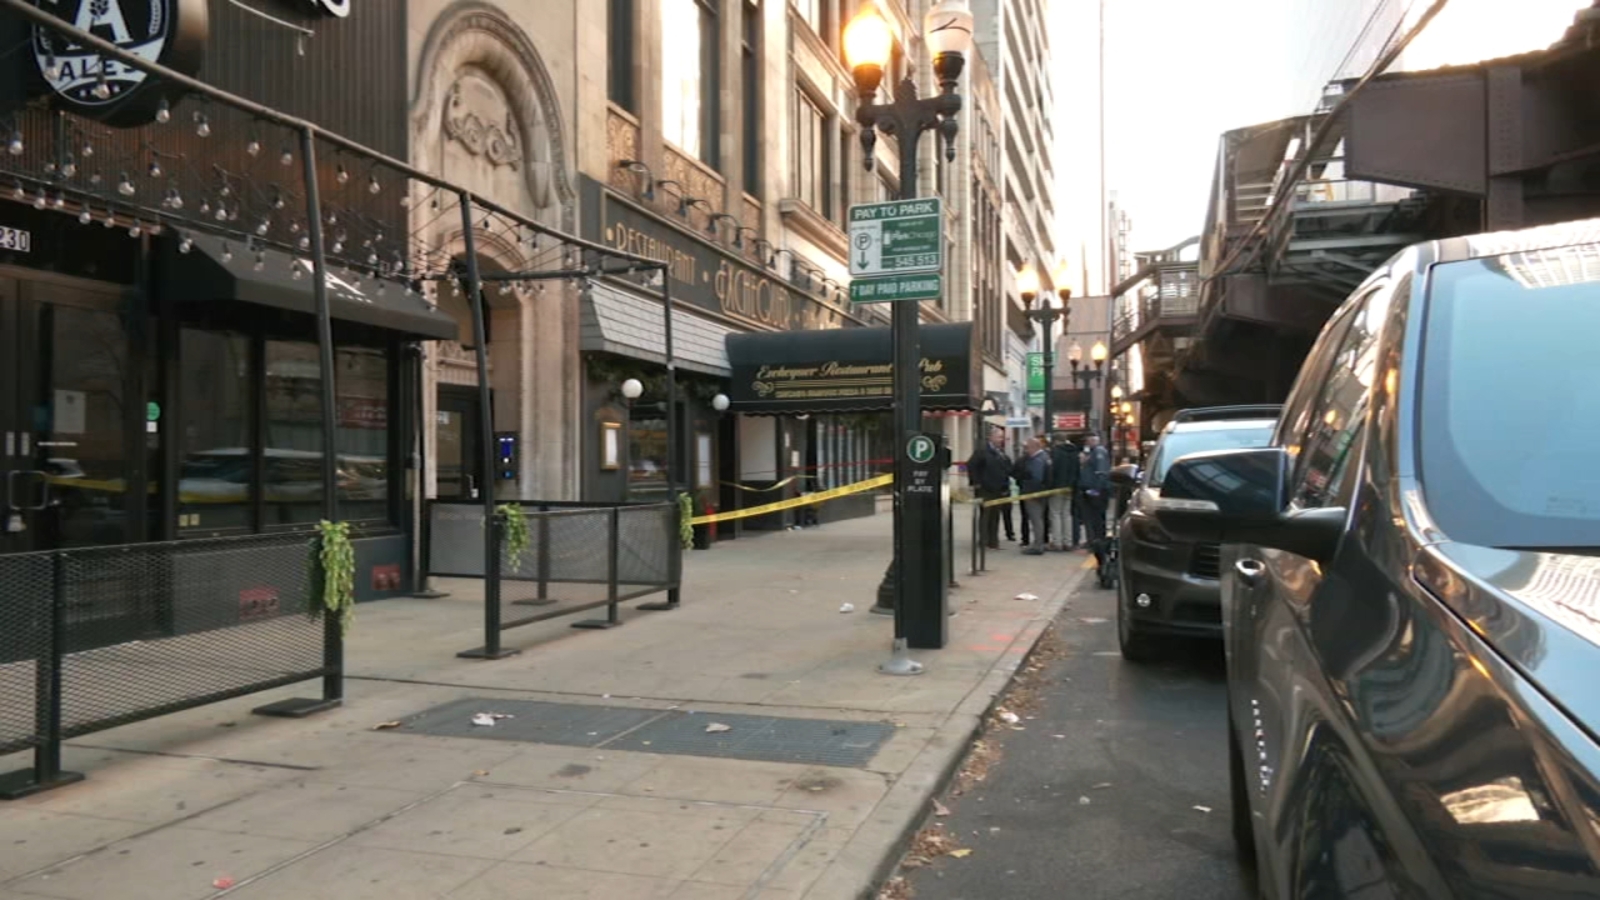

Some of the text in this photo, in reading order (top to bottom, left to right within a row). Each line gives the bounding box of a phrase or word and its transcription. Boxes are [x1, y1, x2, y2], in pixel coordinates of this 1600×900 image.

[854, 202, 933, 220] PAY TO PARK
[895, 255, 915, 267] 545
[918, 254, 937, 265] 513
[851, 279, 939, 297] 7 DAY PAID PARKING
[818, 361, 893, 378] Restaurant
[915, 440, 928, 458] P
[907, 485, 934, 493] PLATE
